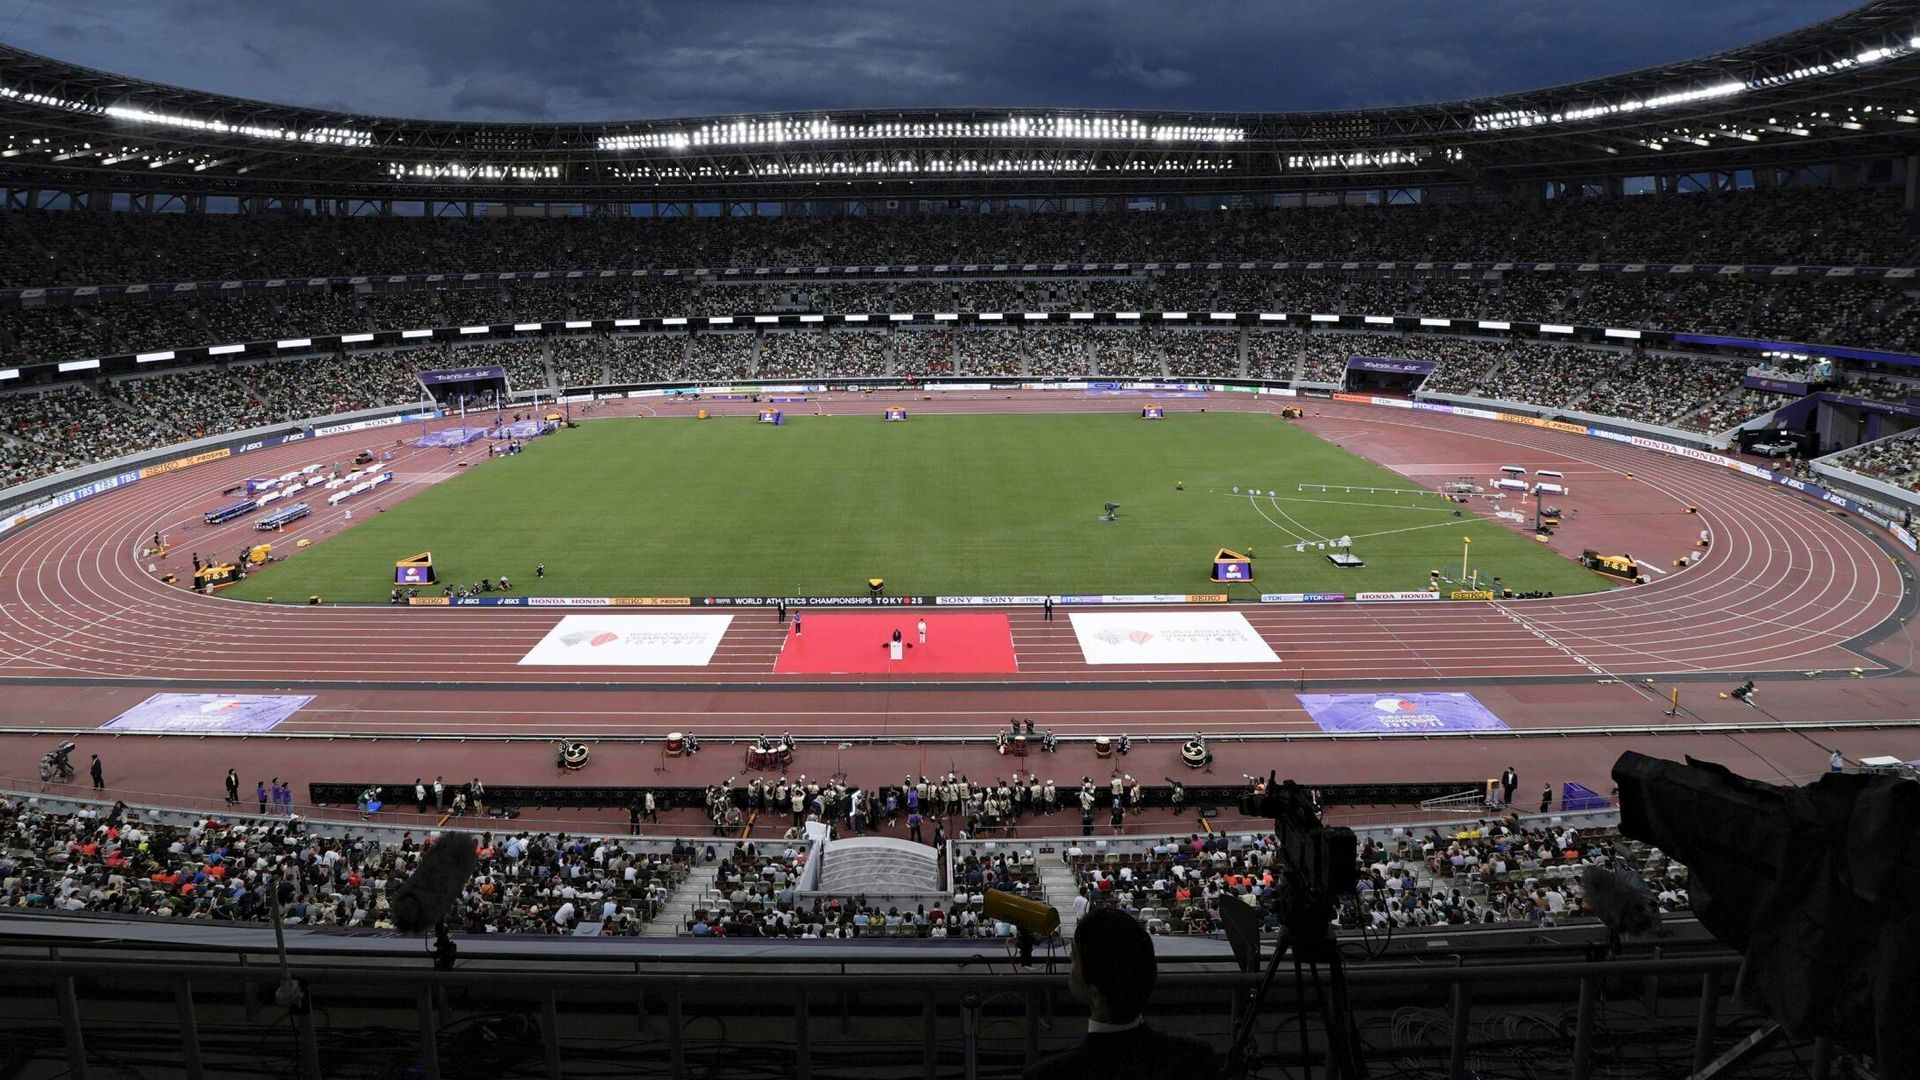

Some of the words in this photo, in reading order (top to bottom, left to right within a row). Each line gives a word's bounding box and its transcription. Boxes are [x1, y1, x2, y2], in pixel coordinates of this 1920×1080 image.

[321, 423, 352, 435] SONY
[364, 417, 397, 427] SONY
[1502, 414, 1535, 425] SEIKO
[1552, 422, 1585, 433] PROSPEX
[1600, 430, 1631, 443] MONDO
[1634, 437, 1678, 452] HONDA
[1682, 448, 1726, 465] HONDA
[145, 460, 179, 477] SEIKO
[196, 449, 230, 462] PROSPEX
[119, 473, 137, 484] TBS
[77, 486, 93, 498] TBS
[735, 597, 763, 605] WORLD
[766, 597, 807, 605] ATHETICS
[809, 597, 873, 605] CHAMPIONSHIPS
[1453, 592, 1484, 600] SEIKO
